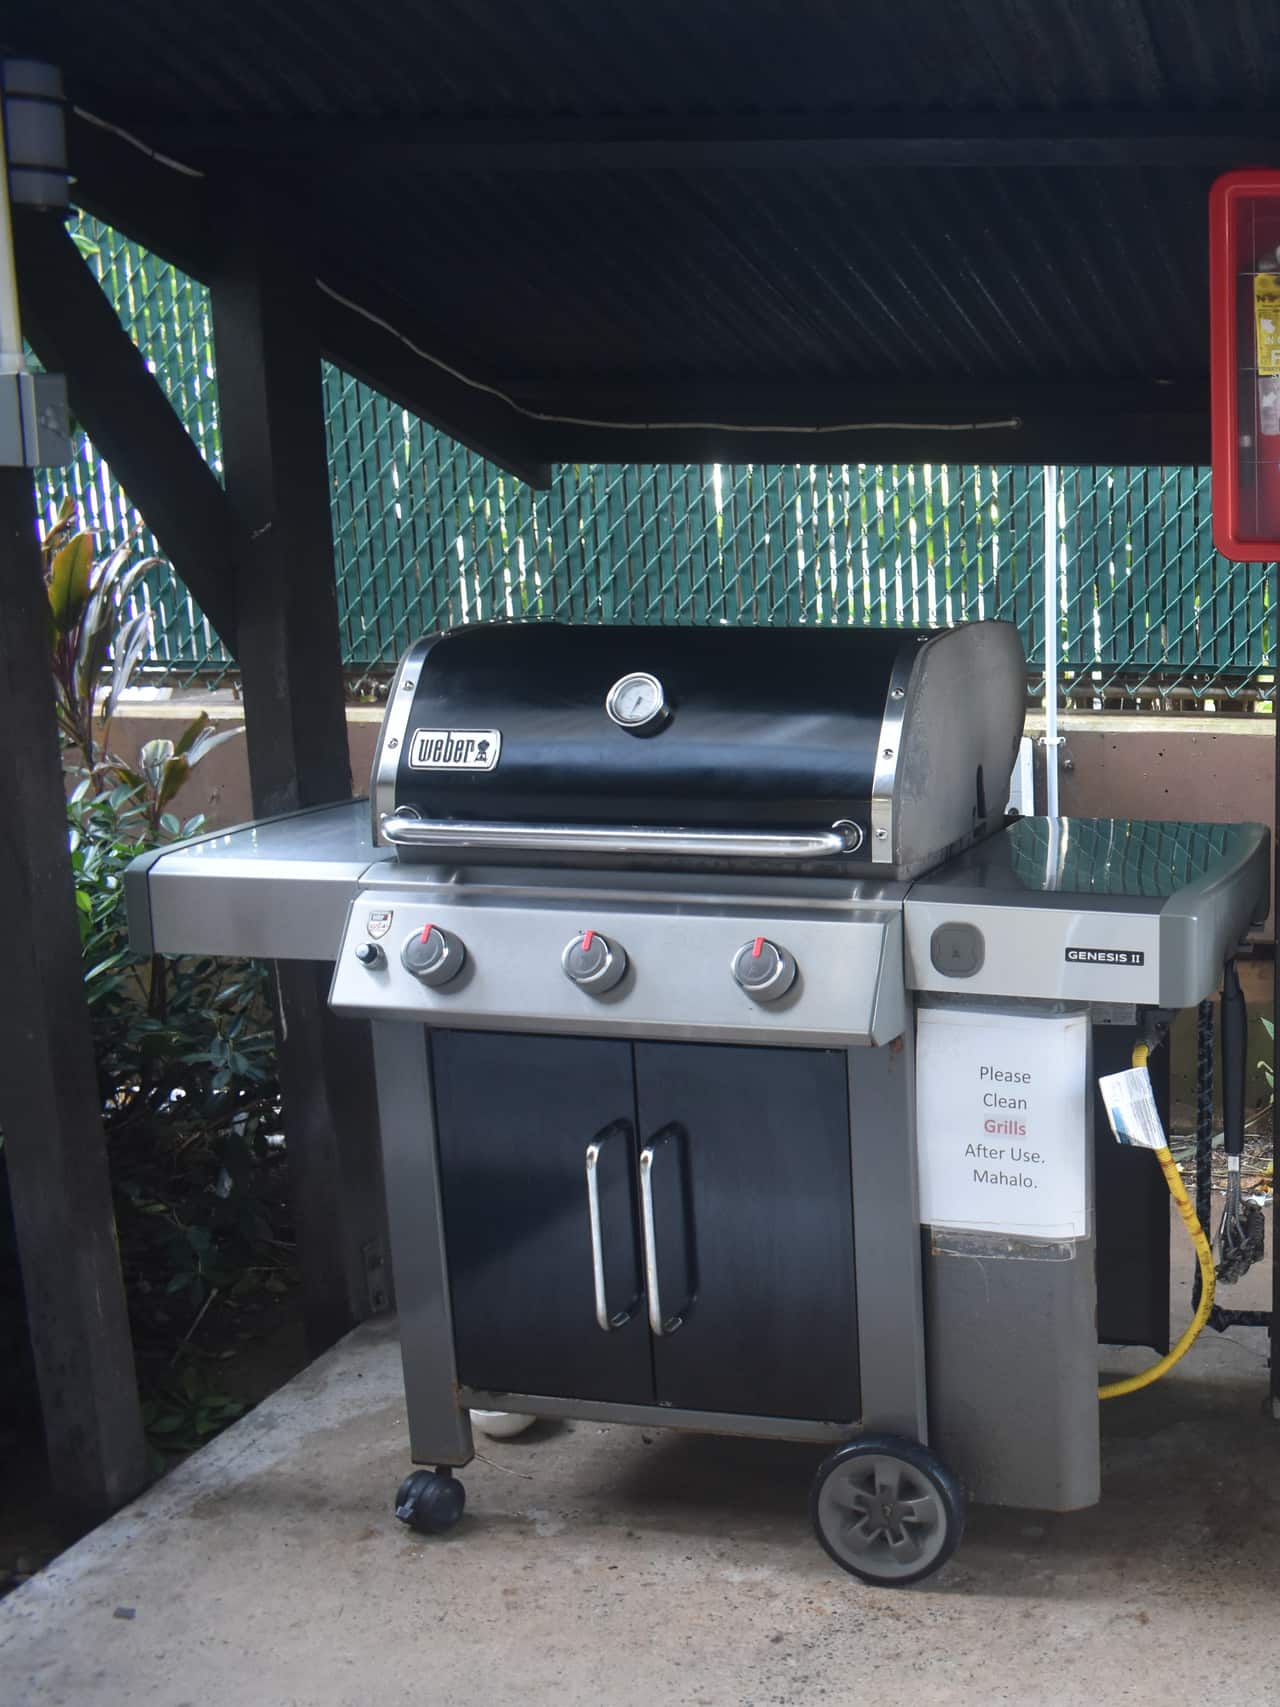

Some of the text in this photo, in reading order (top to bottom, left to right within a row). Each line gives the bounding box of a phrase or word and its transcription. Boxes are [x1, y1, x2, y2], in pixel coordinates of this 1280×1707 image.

[418, 730, 475, 763] weber
[1068, 950, 1128, 963] GENESIS
[980, 1066, 1031, 1084] Please
[983, 1092, 1027, 1110] Clean
[984, 1119, 1026, 1136] Grills
[965, 1143, 1045, 1164] After Use.
[973, 1168, 1038, 1189] Mahalo.
